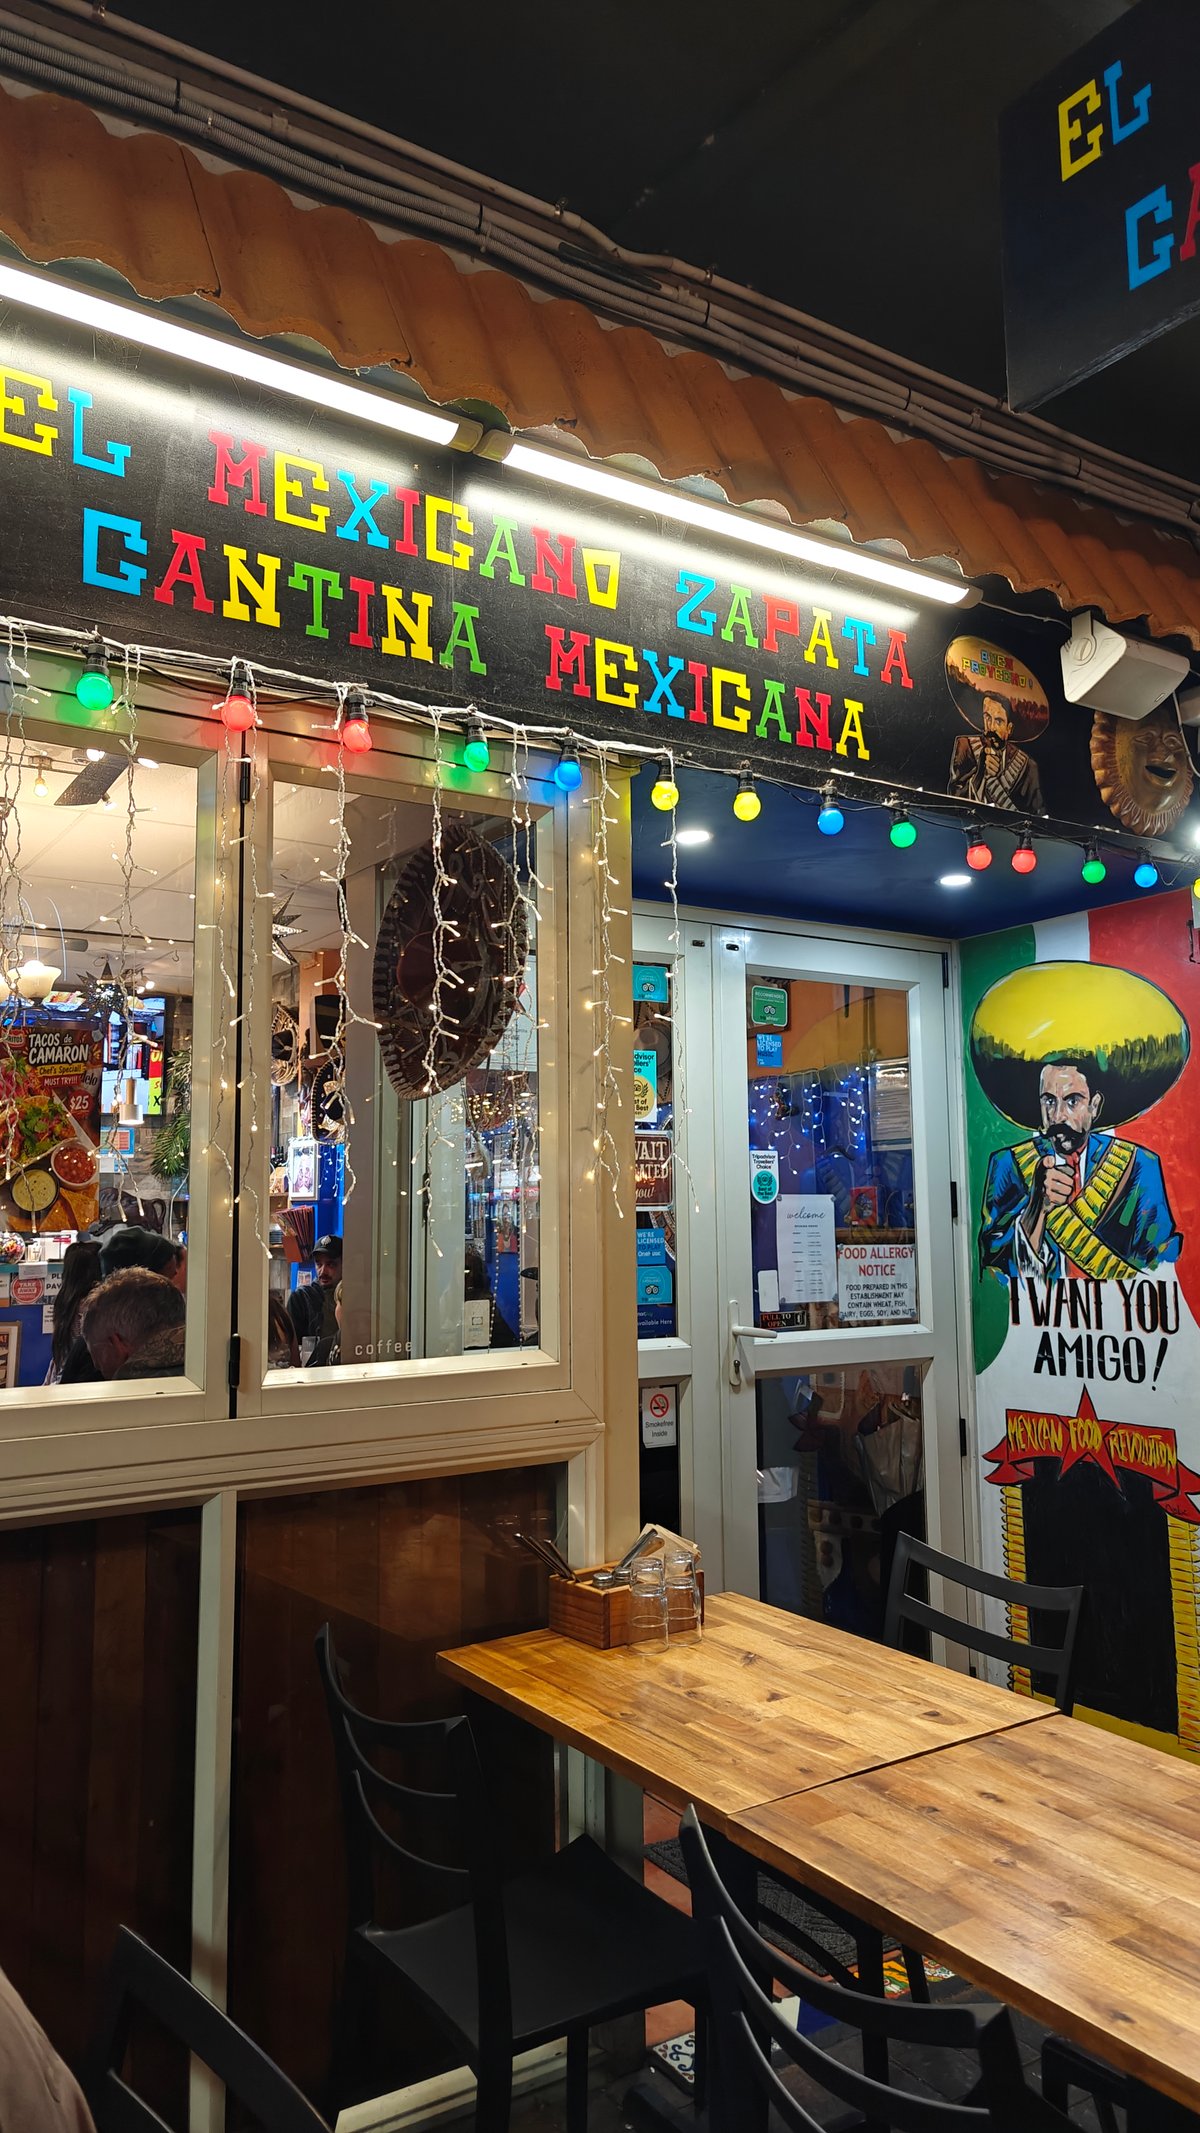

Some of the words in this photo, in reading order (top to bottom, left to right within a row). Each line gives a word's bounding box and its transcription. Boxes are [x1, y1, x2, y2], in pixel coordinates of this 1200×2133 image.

[1058, 60, 1152, 182] EL
[0, 366, 131, 477] EL
[208, 429, 620, 610] MEXICANO
[676, 569, 913, 689] ZAPATA
[83, 508, 488, 676] CANTINA
[544, 625, 870, 760] MEXICANA
[28, 1033, 60, 1047] TACOS
[63, 1034, 73, 1044] de
[28, 1044, 89, 1064] CAMARON
[39, 1066, 57, 1075] Chef's
[44, 1078, 60, 1086] MUST
[69, 1096, 89, 1110] $25
[787, 1206, 826, 1219] welcome
[837, 1247, 867, 1260] FOOD
[870, 1247, 914, 1259] ALLERGY
[858, 1264, 896, 1276] NOTICE
[862, 1283, 889, 1291] PREPARED
[850, 1292, 893, 1300] ESTABLISHMENT
[1010, 1277, 1021, 1326] I
[1026, 1277, 1107, 1330] WANT
[1117, 1279, 1180, 1335] YOU
[859, 1310, 875, 1318] EGGS,
[355, 1339, 413, 1356] coffee
[1033, 1331, 1169, 1391] AMIGO!
[645, 1420, 674, 1428] Smokefree
[1007, 1415, 1063, 1452] MEXICAN
[1068, 1417, 1103, 1452] FOOD
[1109, 1429, 1177, 1476] REVOLUTION
